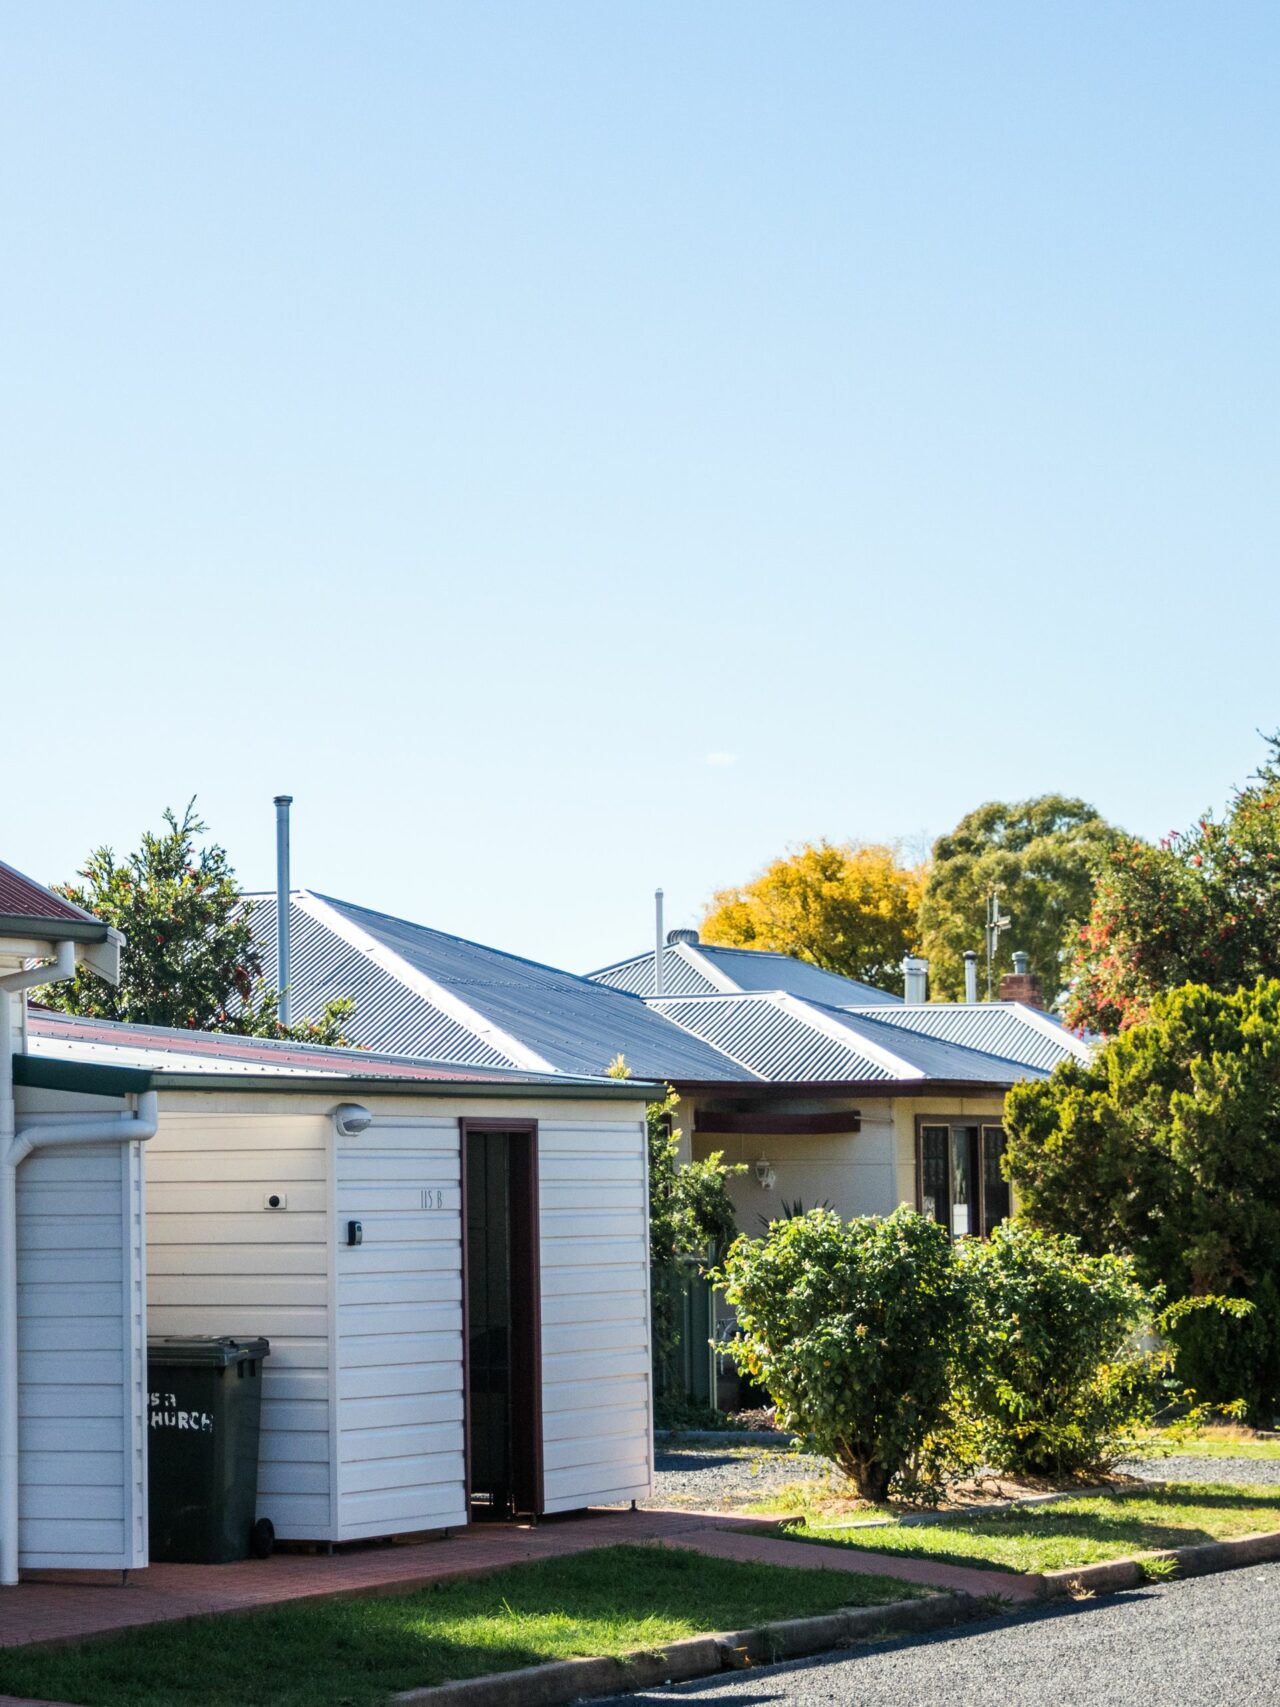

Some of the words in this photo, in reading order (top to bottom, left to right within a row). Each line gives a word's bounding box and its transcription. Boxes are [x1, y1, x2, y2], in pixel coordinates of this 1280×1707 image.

[420, 1190, 433, 1209] 115
[436, 1190, 443, 1209] B
[147, 1411, 214, 1433] HURCH
